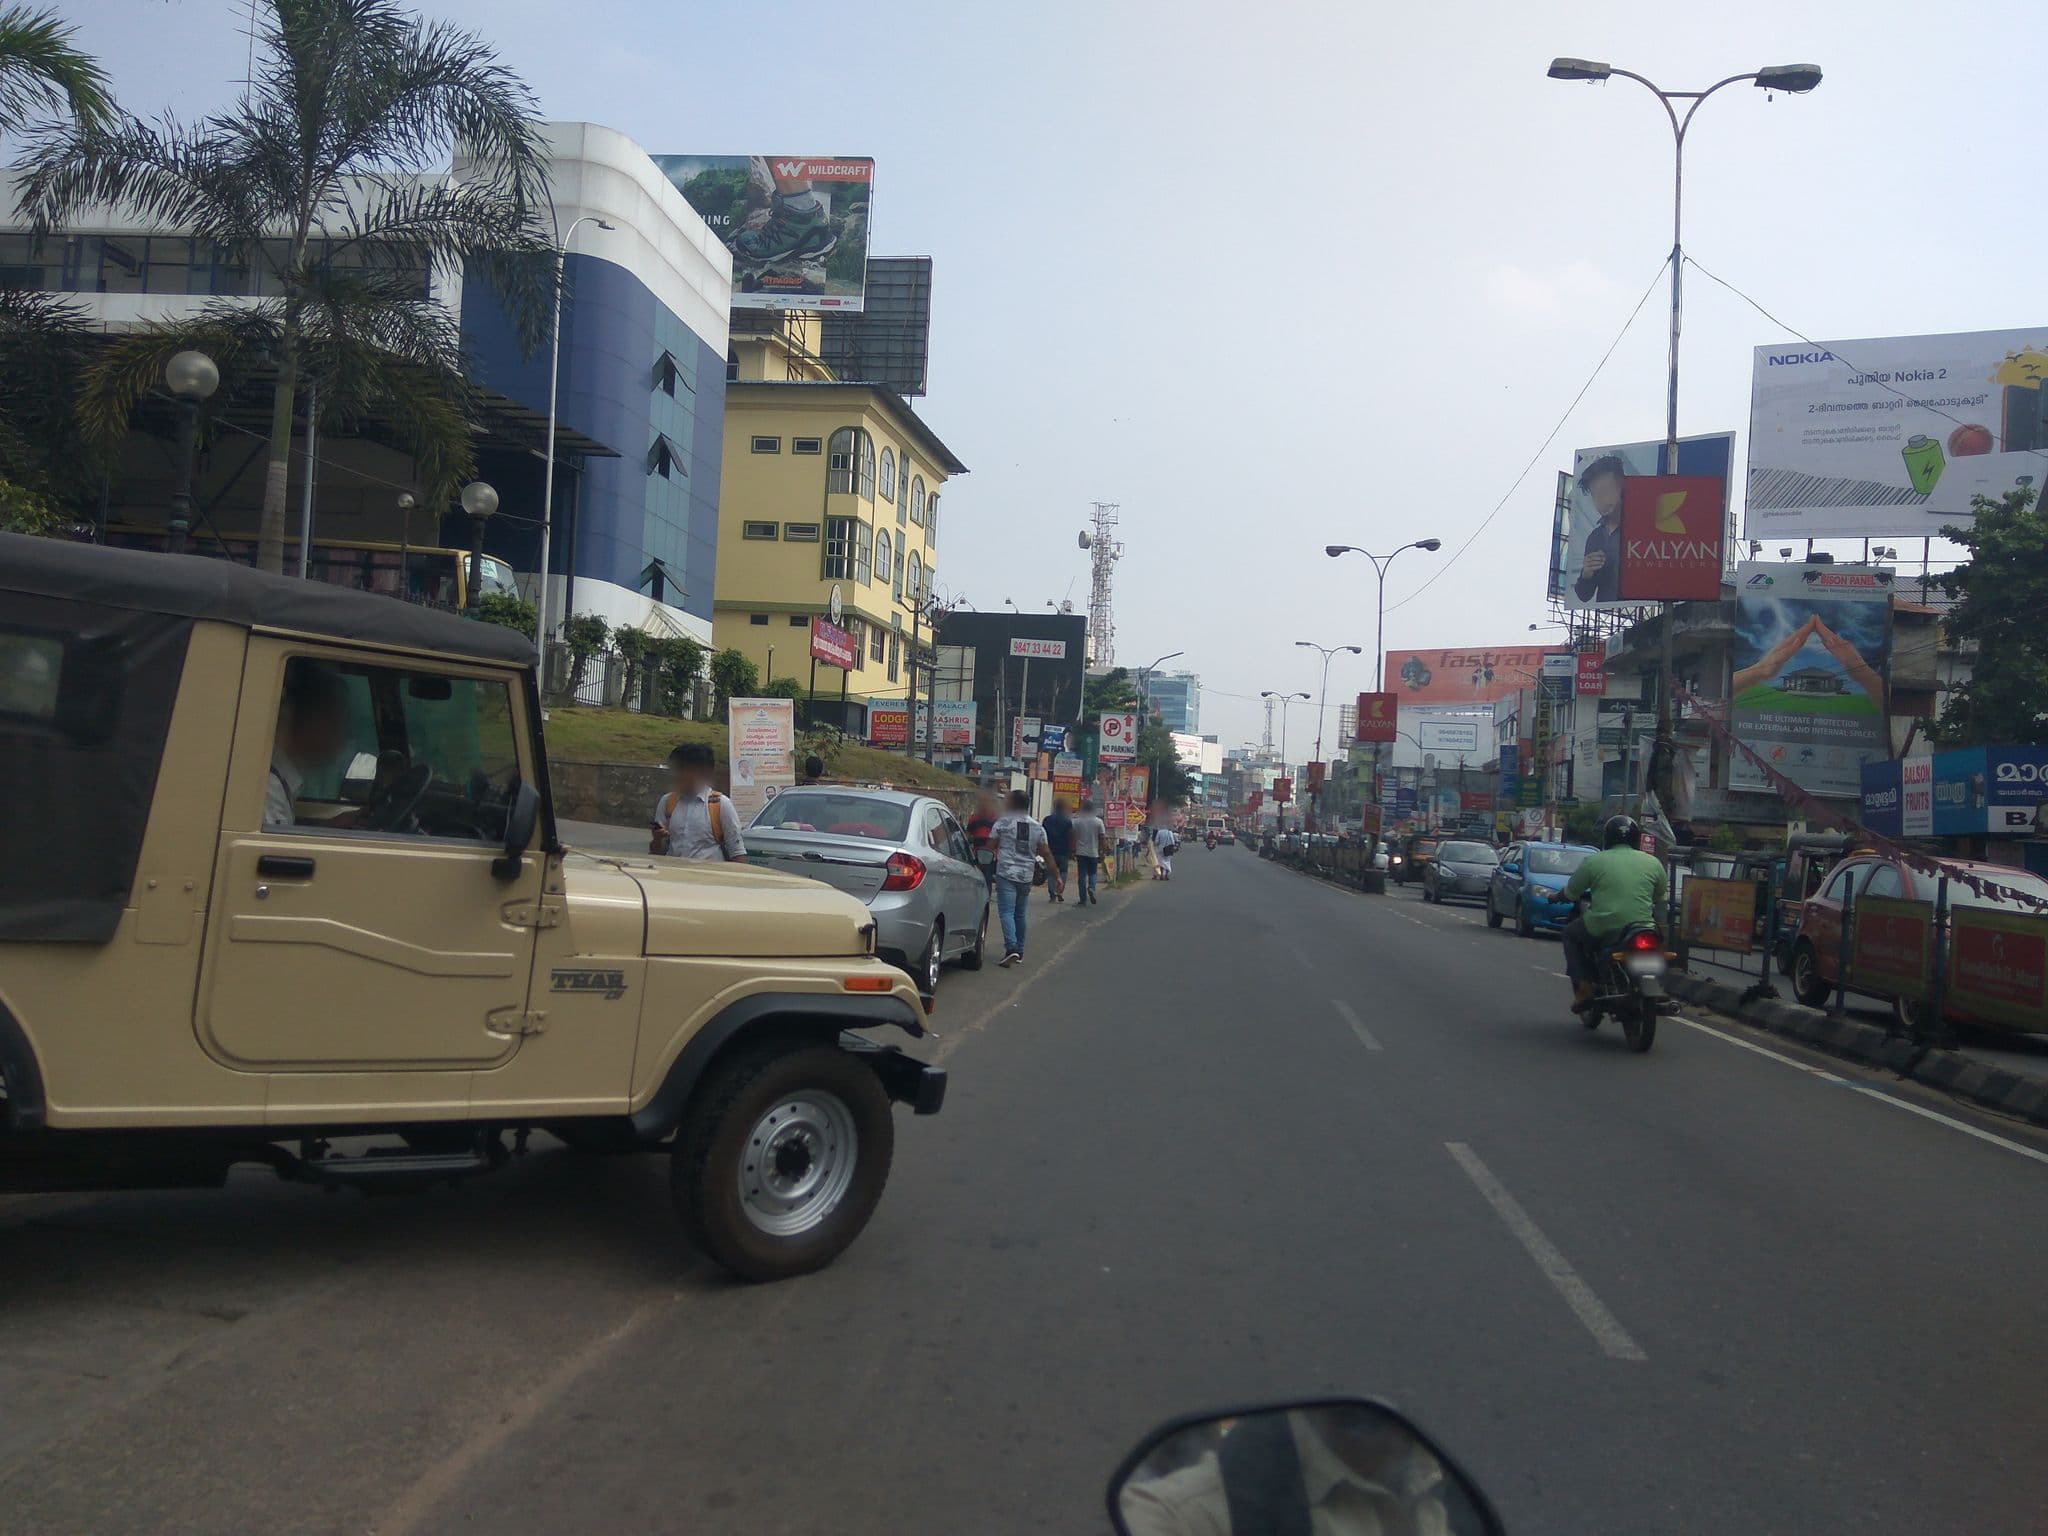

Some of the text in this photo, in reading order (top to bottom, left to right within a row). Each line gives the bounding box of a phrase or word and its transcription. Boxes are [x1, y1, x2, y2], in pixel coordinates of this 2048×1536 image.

[808, 165, 868, 176] WILDCRAFT
[1768, 351, 1836, 367] NOKIA
[1894, 369, 1935, 383] Nokia
[1938, 368, 1947, 380] 2
[1627, 540, 1718, 560] KALYAN
[1820, 574, 1876, 587] BISON PANEL
[1013, 641, 1062, 656] 9847 33 44 22
[1579, 671, 1603, 681] GOLD
[1579, 681, 1603, 691] LOAN
[874, 714, 908, 724] LODGE
[1759, 713, 1774, 723] THE
[1775, 714, 1810, 725] ULTIMATE
[1755, 722, 1792, 733] EXTERNAL
[1793, 724, 1810, 734] AND
[1811, 726, 1846, 737] INTERNAL
[1102, 745, 1135, 753] NO PARKING
[1904, 765, 1930, 785] BALSON
[1905, 791, 1930, 812] FRUITS
